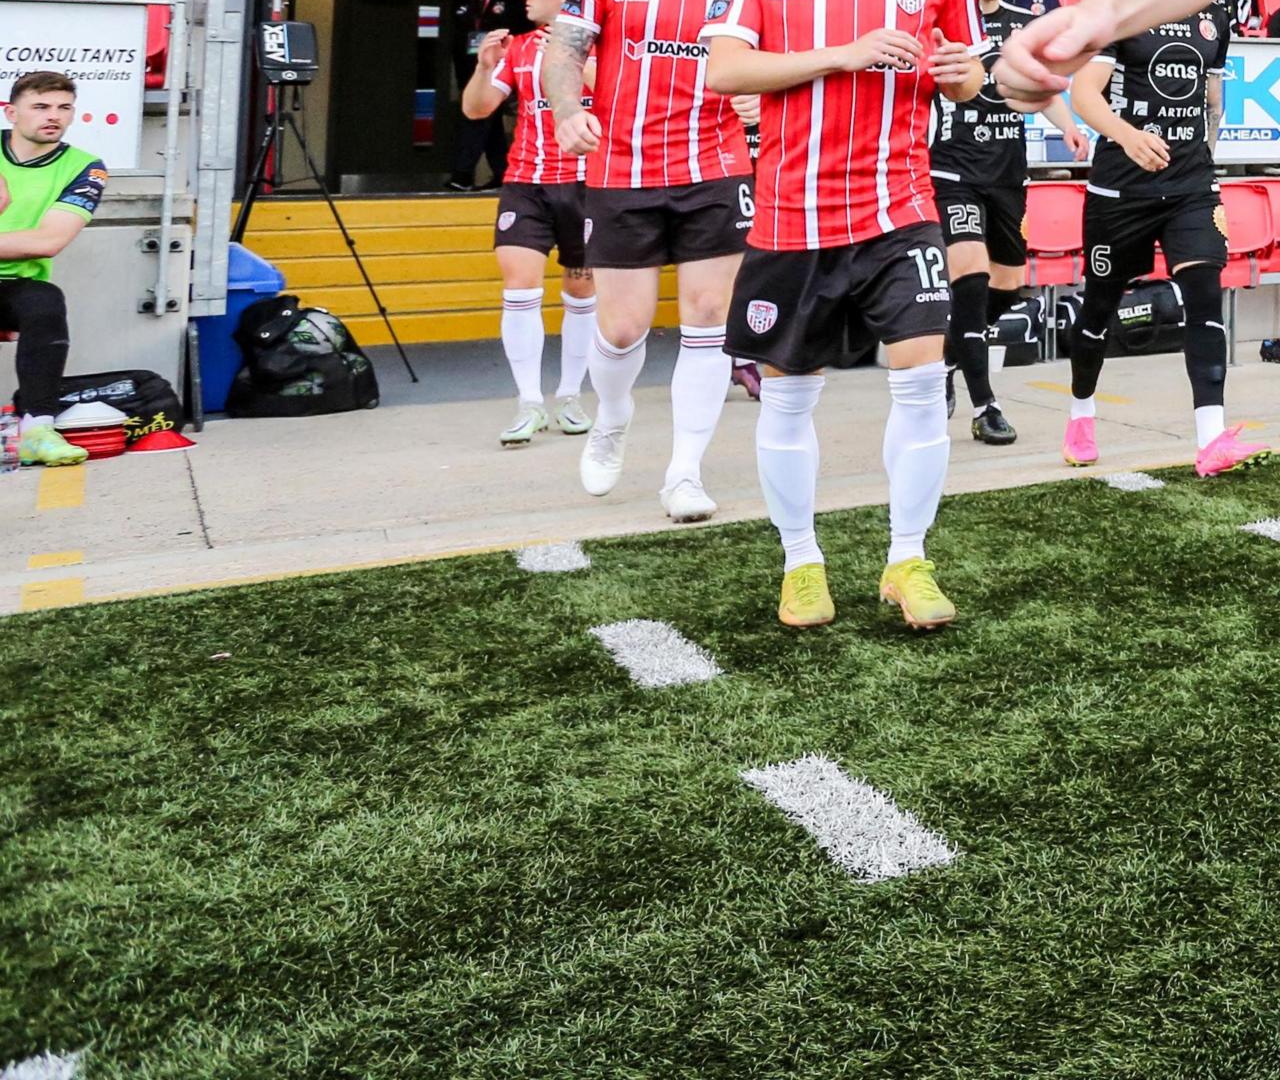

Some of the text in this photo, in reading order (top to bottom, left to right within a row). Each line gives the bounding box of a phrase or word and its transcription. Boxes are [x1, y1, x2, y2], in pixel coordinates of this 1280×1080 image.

[262, 24, 286, 63] APEX
[647, 41, 711, 58] DIAMON
[6, 47, 137, 64] CONSULTANTS
[1154, 62, 1198, 80] sms
[994, 126, 1020, 139] LNS
[1167, 126, 1194, 141] LNS
[1219, 129, 1272, 140] AHEAD
[737, 183, 756, 218] 6
[906, 246, 949, 289] 12
[1090, 245, 1112, 277] 6
[1117, 303, 1153, 320] SELECT
